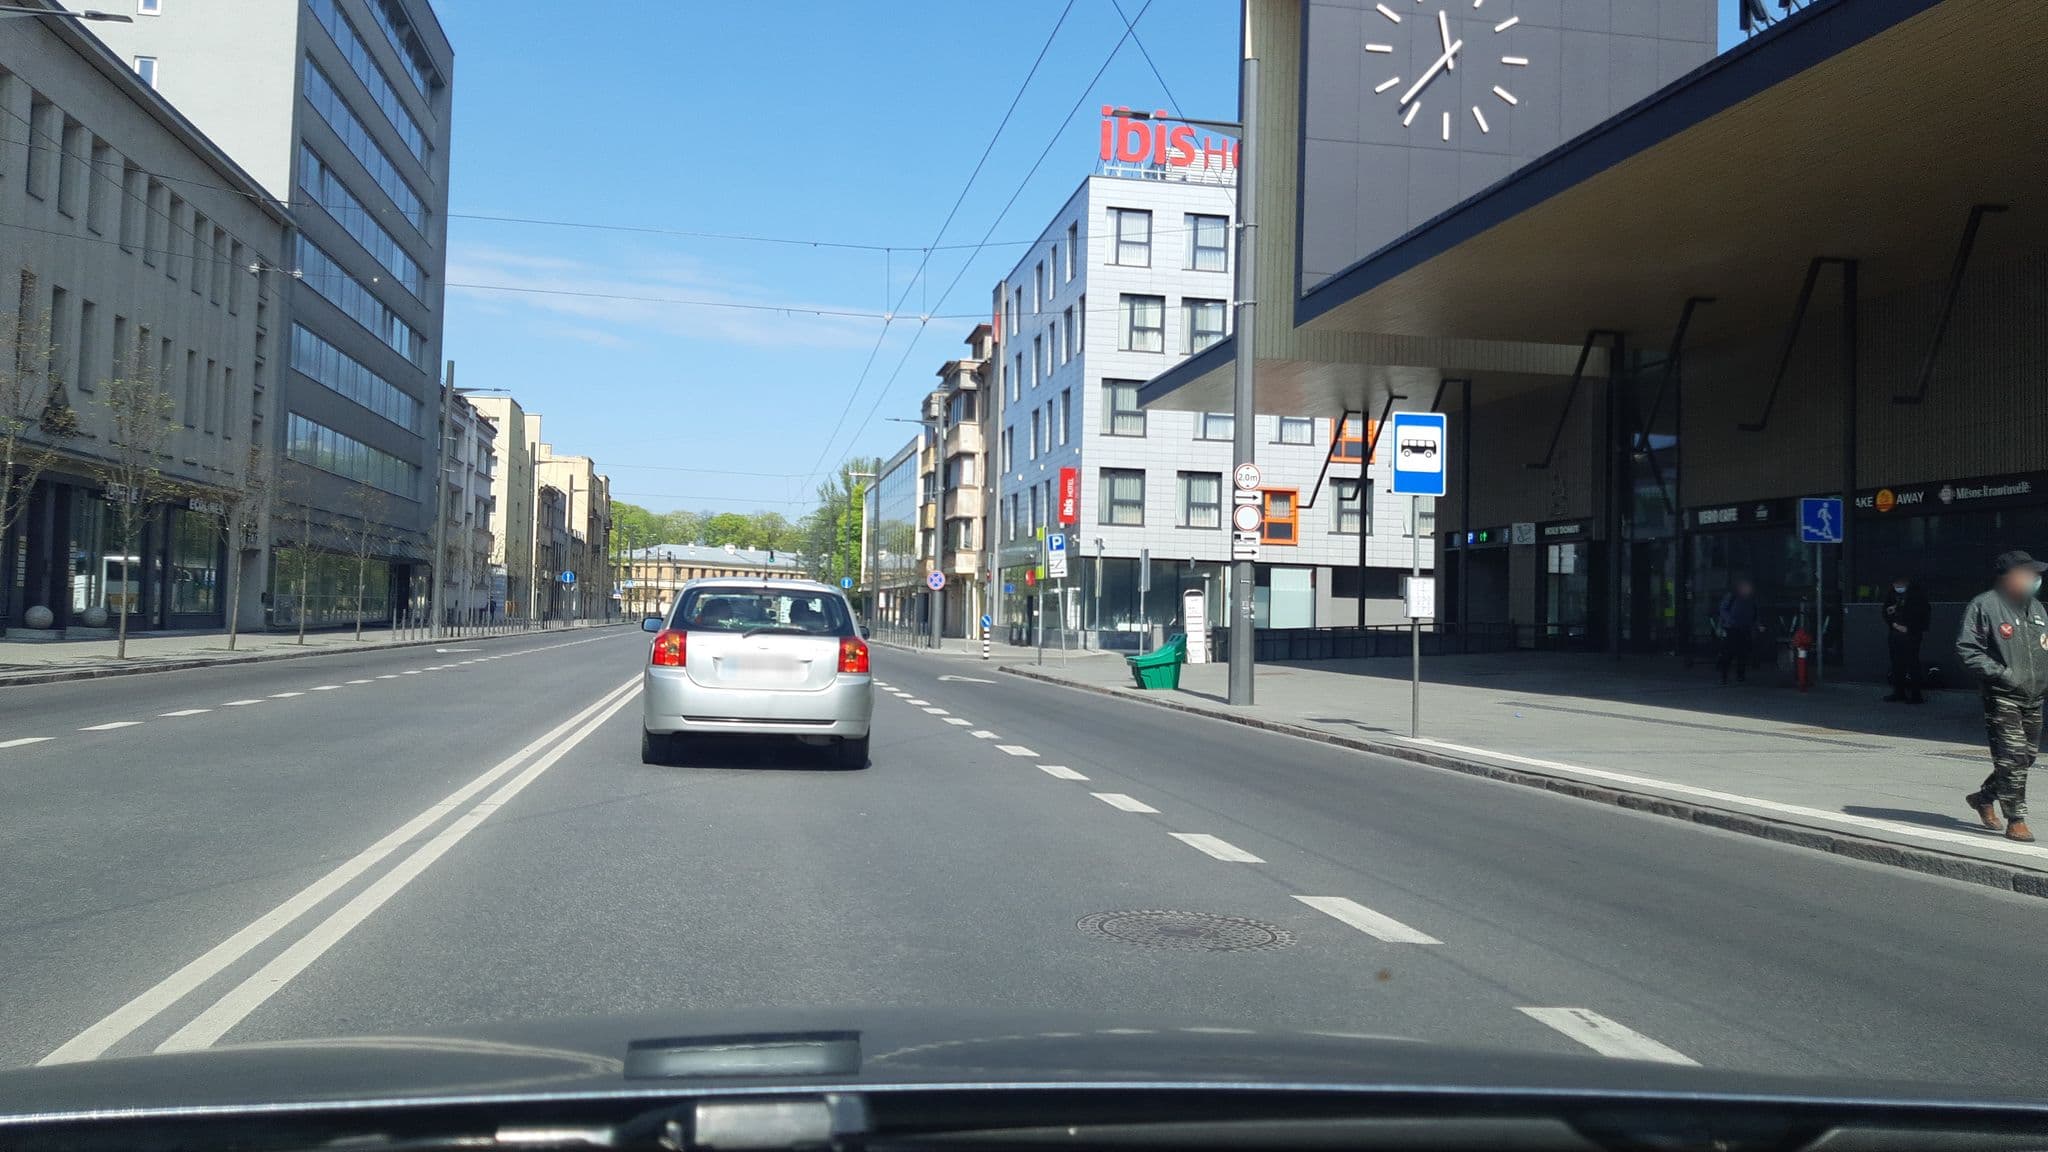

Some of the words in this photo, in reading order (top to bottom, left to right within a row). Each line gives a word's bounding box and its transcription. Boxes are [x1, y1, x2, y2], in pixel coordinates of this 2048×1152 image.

[1100, 104, 1195, 167] ibis
[1063, 498, 1074, 516] ibis
[1855, 496, 1874, 509] AKE
[1896, 491, 1925, 505] AWAY
[1052, 536, 1062, 551] P
